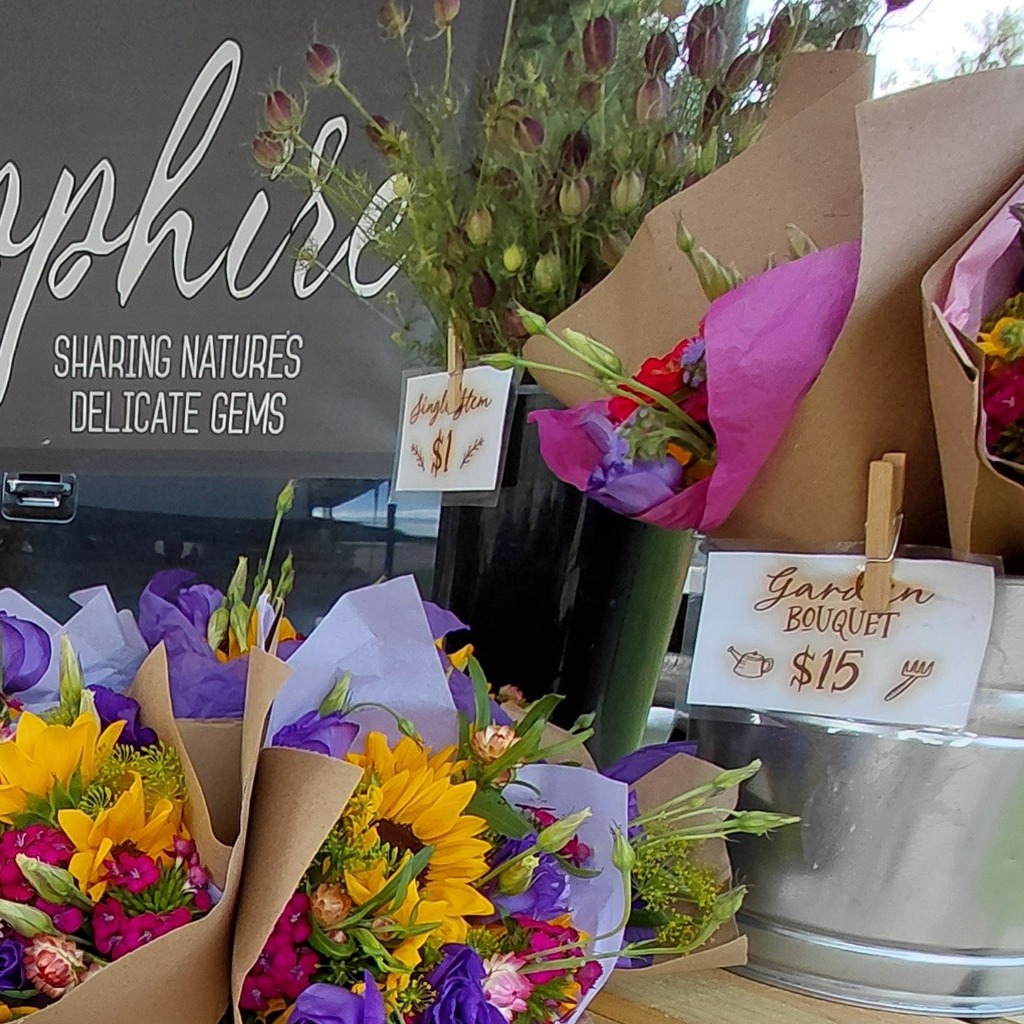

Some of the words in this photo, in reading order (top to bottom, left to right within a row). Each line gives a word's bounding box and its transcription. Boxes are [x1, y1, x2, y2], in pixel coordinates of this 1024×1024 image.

[54, 334, 172, 379] SHARING
[71, 390, 202, 435] DELICATE
[210, 391, 287, 435] GEMS
[409, 389, 451, 427] Singl
[430, 429, 453, 478] $1
[753, 566, 936, 612] Gardn
[783, 605, 900, 642] BOUQUET
[789, 644, 864, 693] $15
